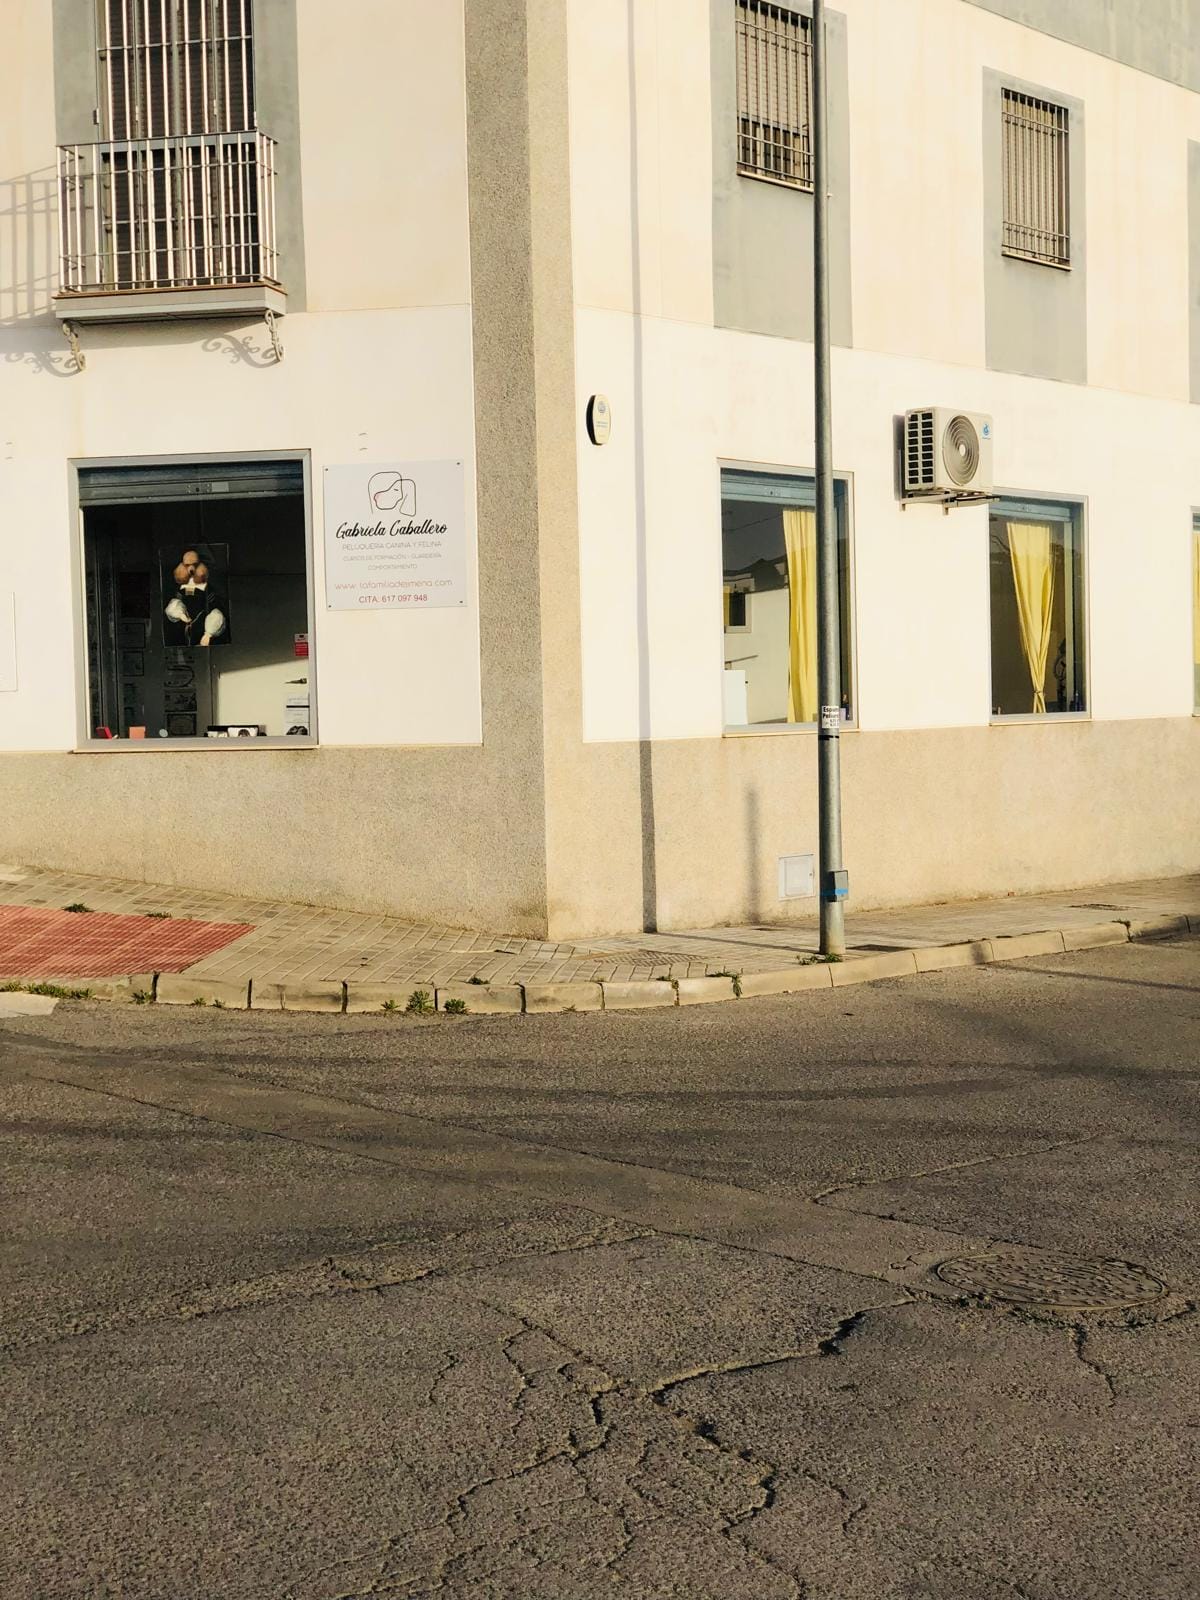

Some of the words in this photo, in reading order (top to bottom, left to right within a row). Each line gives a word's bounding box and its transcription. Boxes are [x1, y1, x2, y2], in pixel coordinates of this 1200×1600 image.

[336, 521, 386, 539] Gabriela
[390, 519, 447, 537] Caballero
[385, 541, 411, 549] CANINA
[418, 540, 442, 548] FELINA
[382, 595, 396, 603] 617
[414, 593, 428, 601] 948
